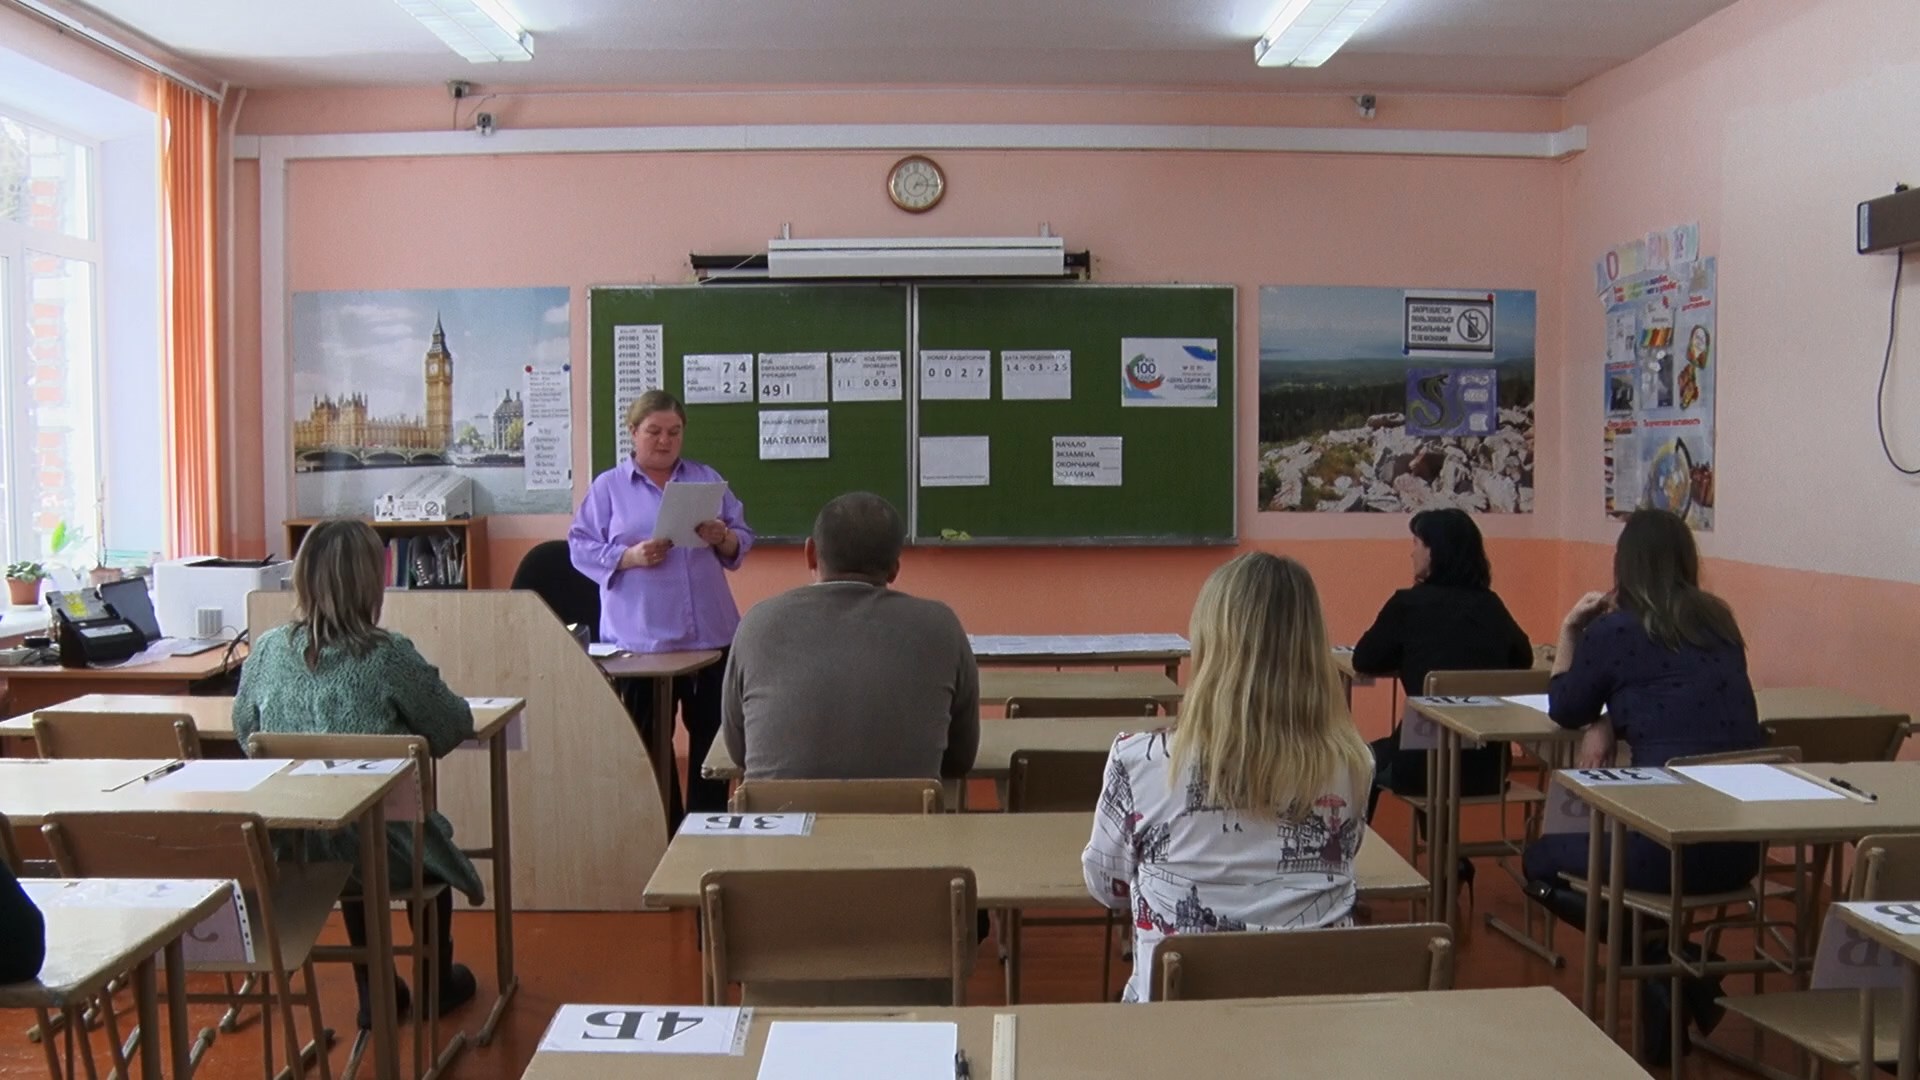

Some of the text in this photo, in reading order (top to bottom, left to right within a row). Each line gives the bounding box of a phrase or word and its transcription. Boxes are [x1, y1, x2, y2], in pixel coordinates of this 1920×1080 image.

[1136, 362, 1156, 374] 100
[705, 815, 785, 830] 3Б
[581, 1010, 704, 1042] 4Б
